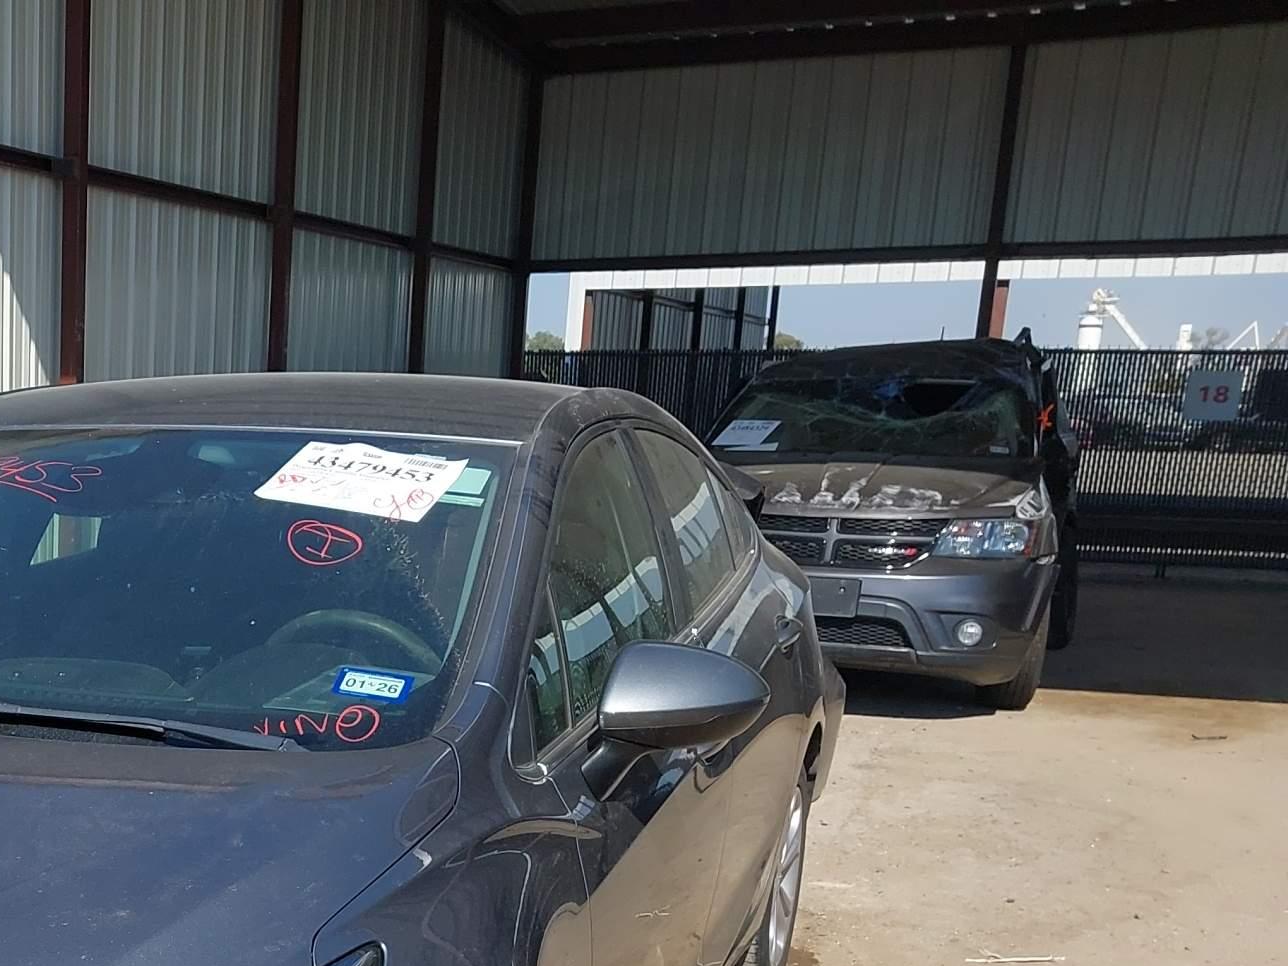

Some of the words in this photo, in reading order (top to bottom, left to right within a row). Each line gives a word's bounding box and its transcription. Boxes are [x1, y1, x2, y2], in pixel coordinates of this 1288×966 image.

[1199, 384, 1230, 404] 18
[307, 455, 436, 482] 43479453
[345, 678, 367, 689] 01
[375, 682, 400, 694] 26
[253, 713, 328, 735] VIN
